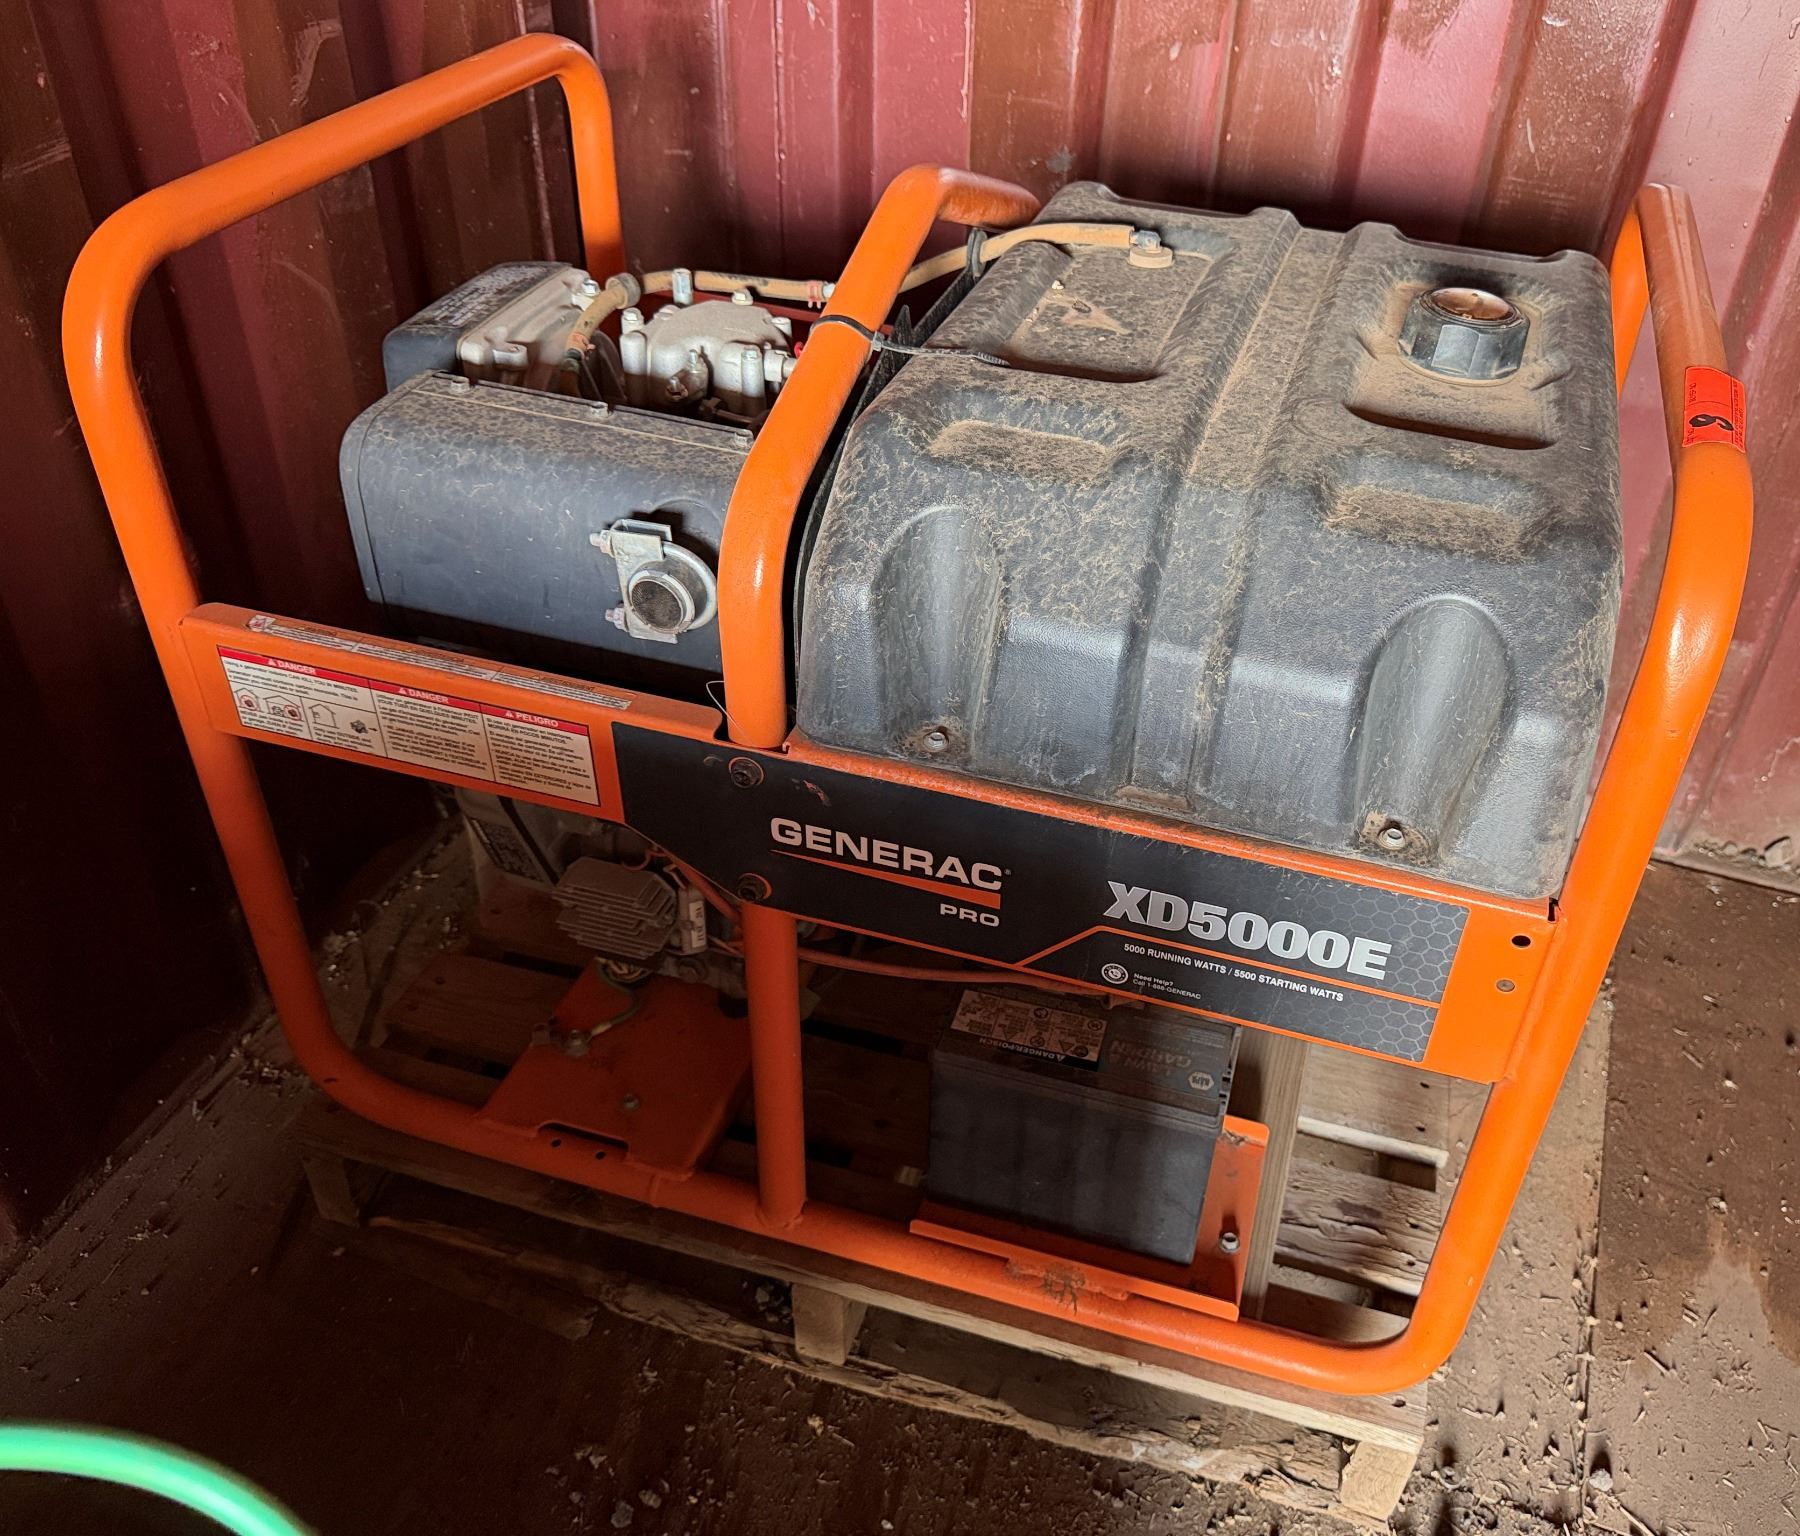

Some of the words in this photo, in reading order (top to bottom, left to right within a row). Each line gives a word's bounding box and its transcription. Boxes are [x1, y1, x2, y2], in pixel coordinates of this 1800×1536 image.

[277, 661, 316, 675] DANGER
[409, 689, 449, 703] DANGER
[515, 712, 558, 727] PELIGRO
[771, 817, 1002, 890] GENERAC
[940, 903, 999, 928] PRO
[1103, 880, 1392, 981] XD5000E
[1124, 944, 1145, 955] 5000
[1147, 948, 1191, 966] RUNNING
[1194, 959, 1226, 974] WATTS
[1234, 968, 1256, 981] 5500
[1258, 975, 1307, 993] STARTING
[1309, 986, 1344, 1002] WATTS
[1133, 972, 1151, 981] Need
[1153, 975, 1173, 986] Help?
